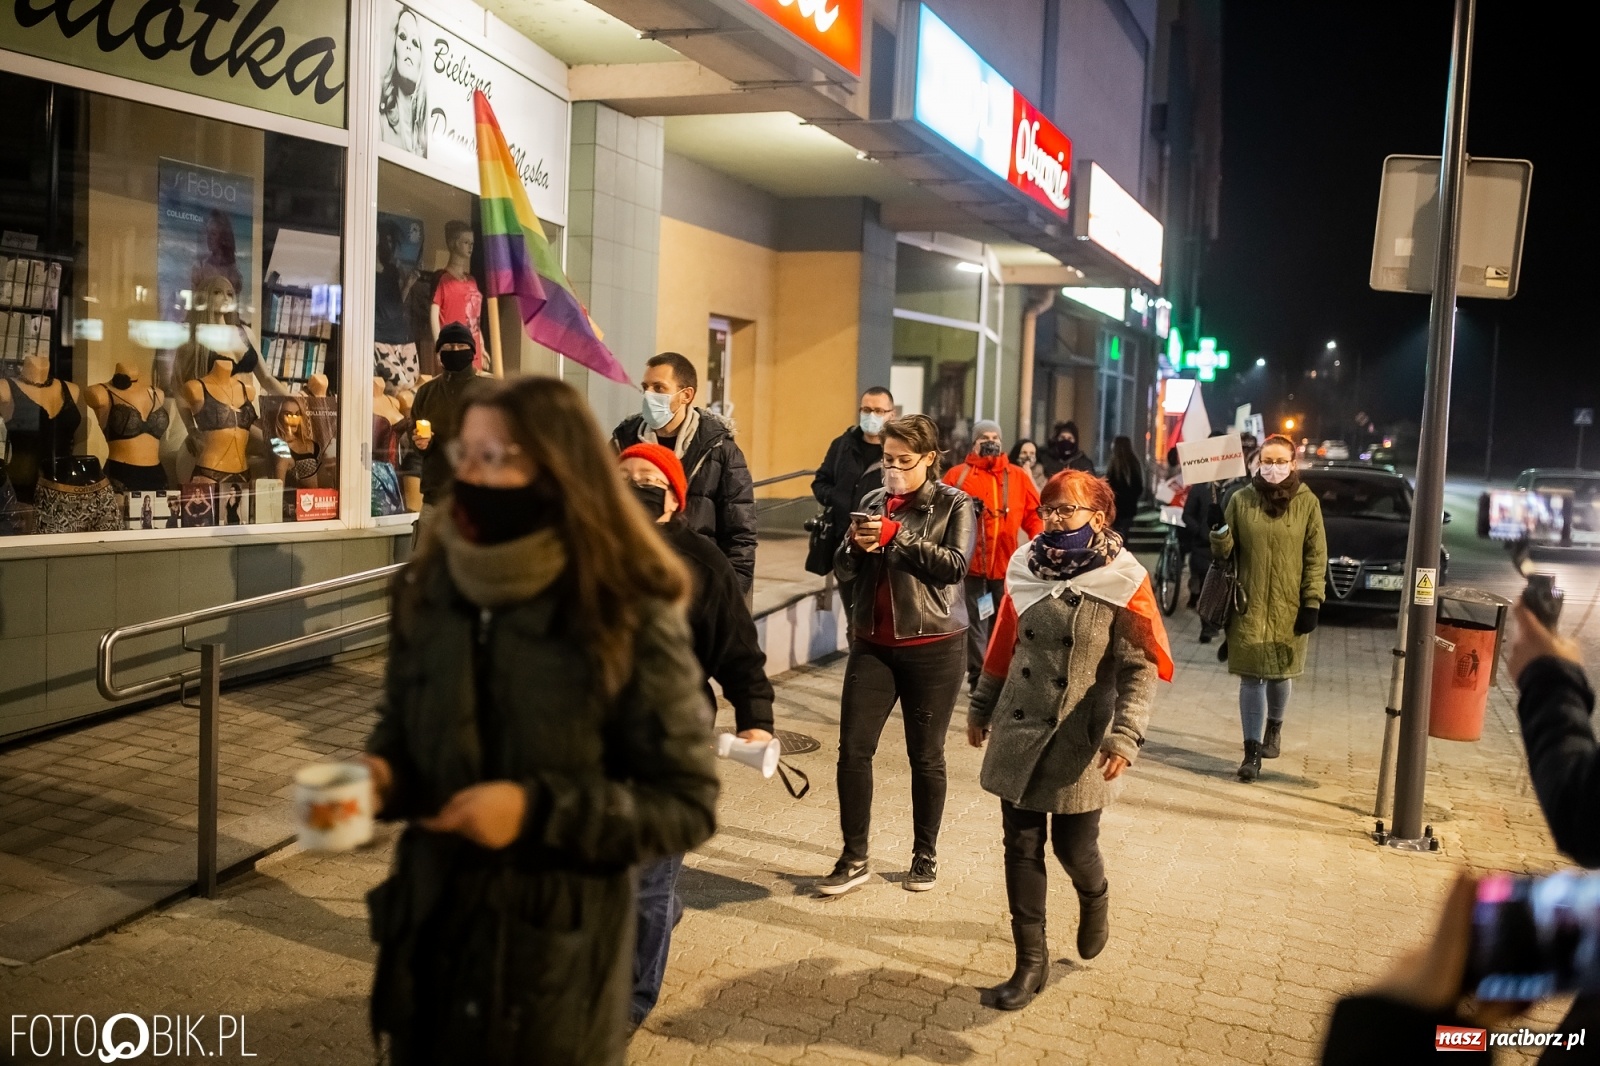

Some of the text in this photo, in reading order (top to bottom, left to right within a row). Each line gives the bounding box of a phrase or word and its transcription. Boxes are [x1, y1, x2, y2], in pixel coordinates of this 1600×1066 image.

[433, 38, 493, 102] Bielizna
[508, 142, 551, 190] Męska
[187, 171, 237, 203] Feba
[166, 209, 204, 222] COLLECTION
[1182, 452, 1242, 467] #WYBÓR NIE ZAKAZ
